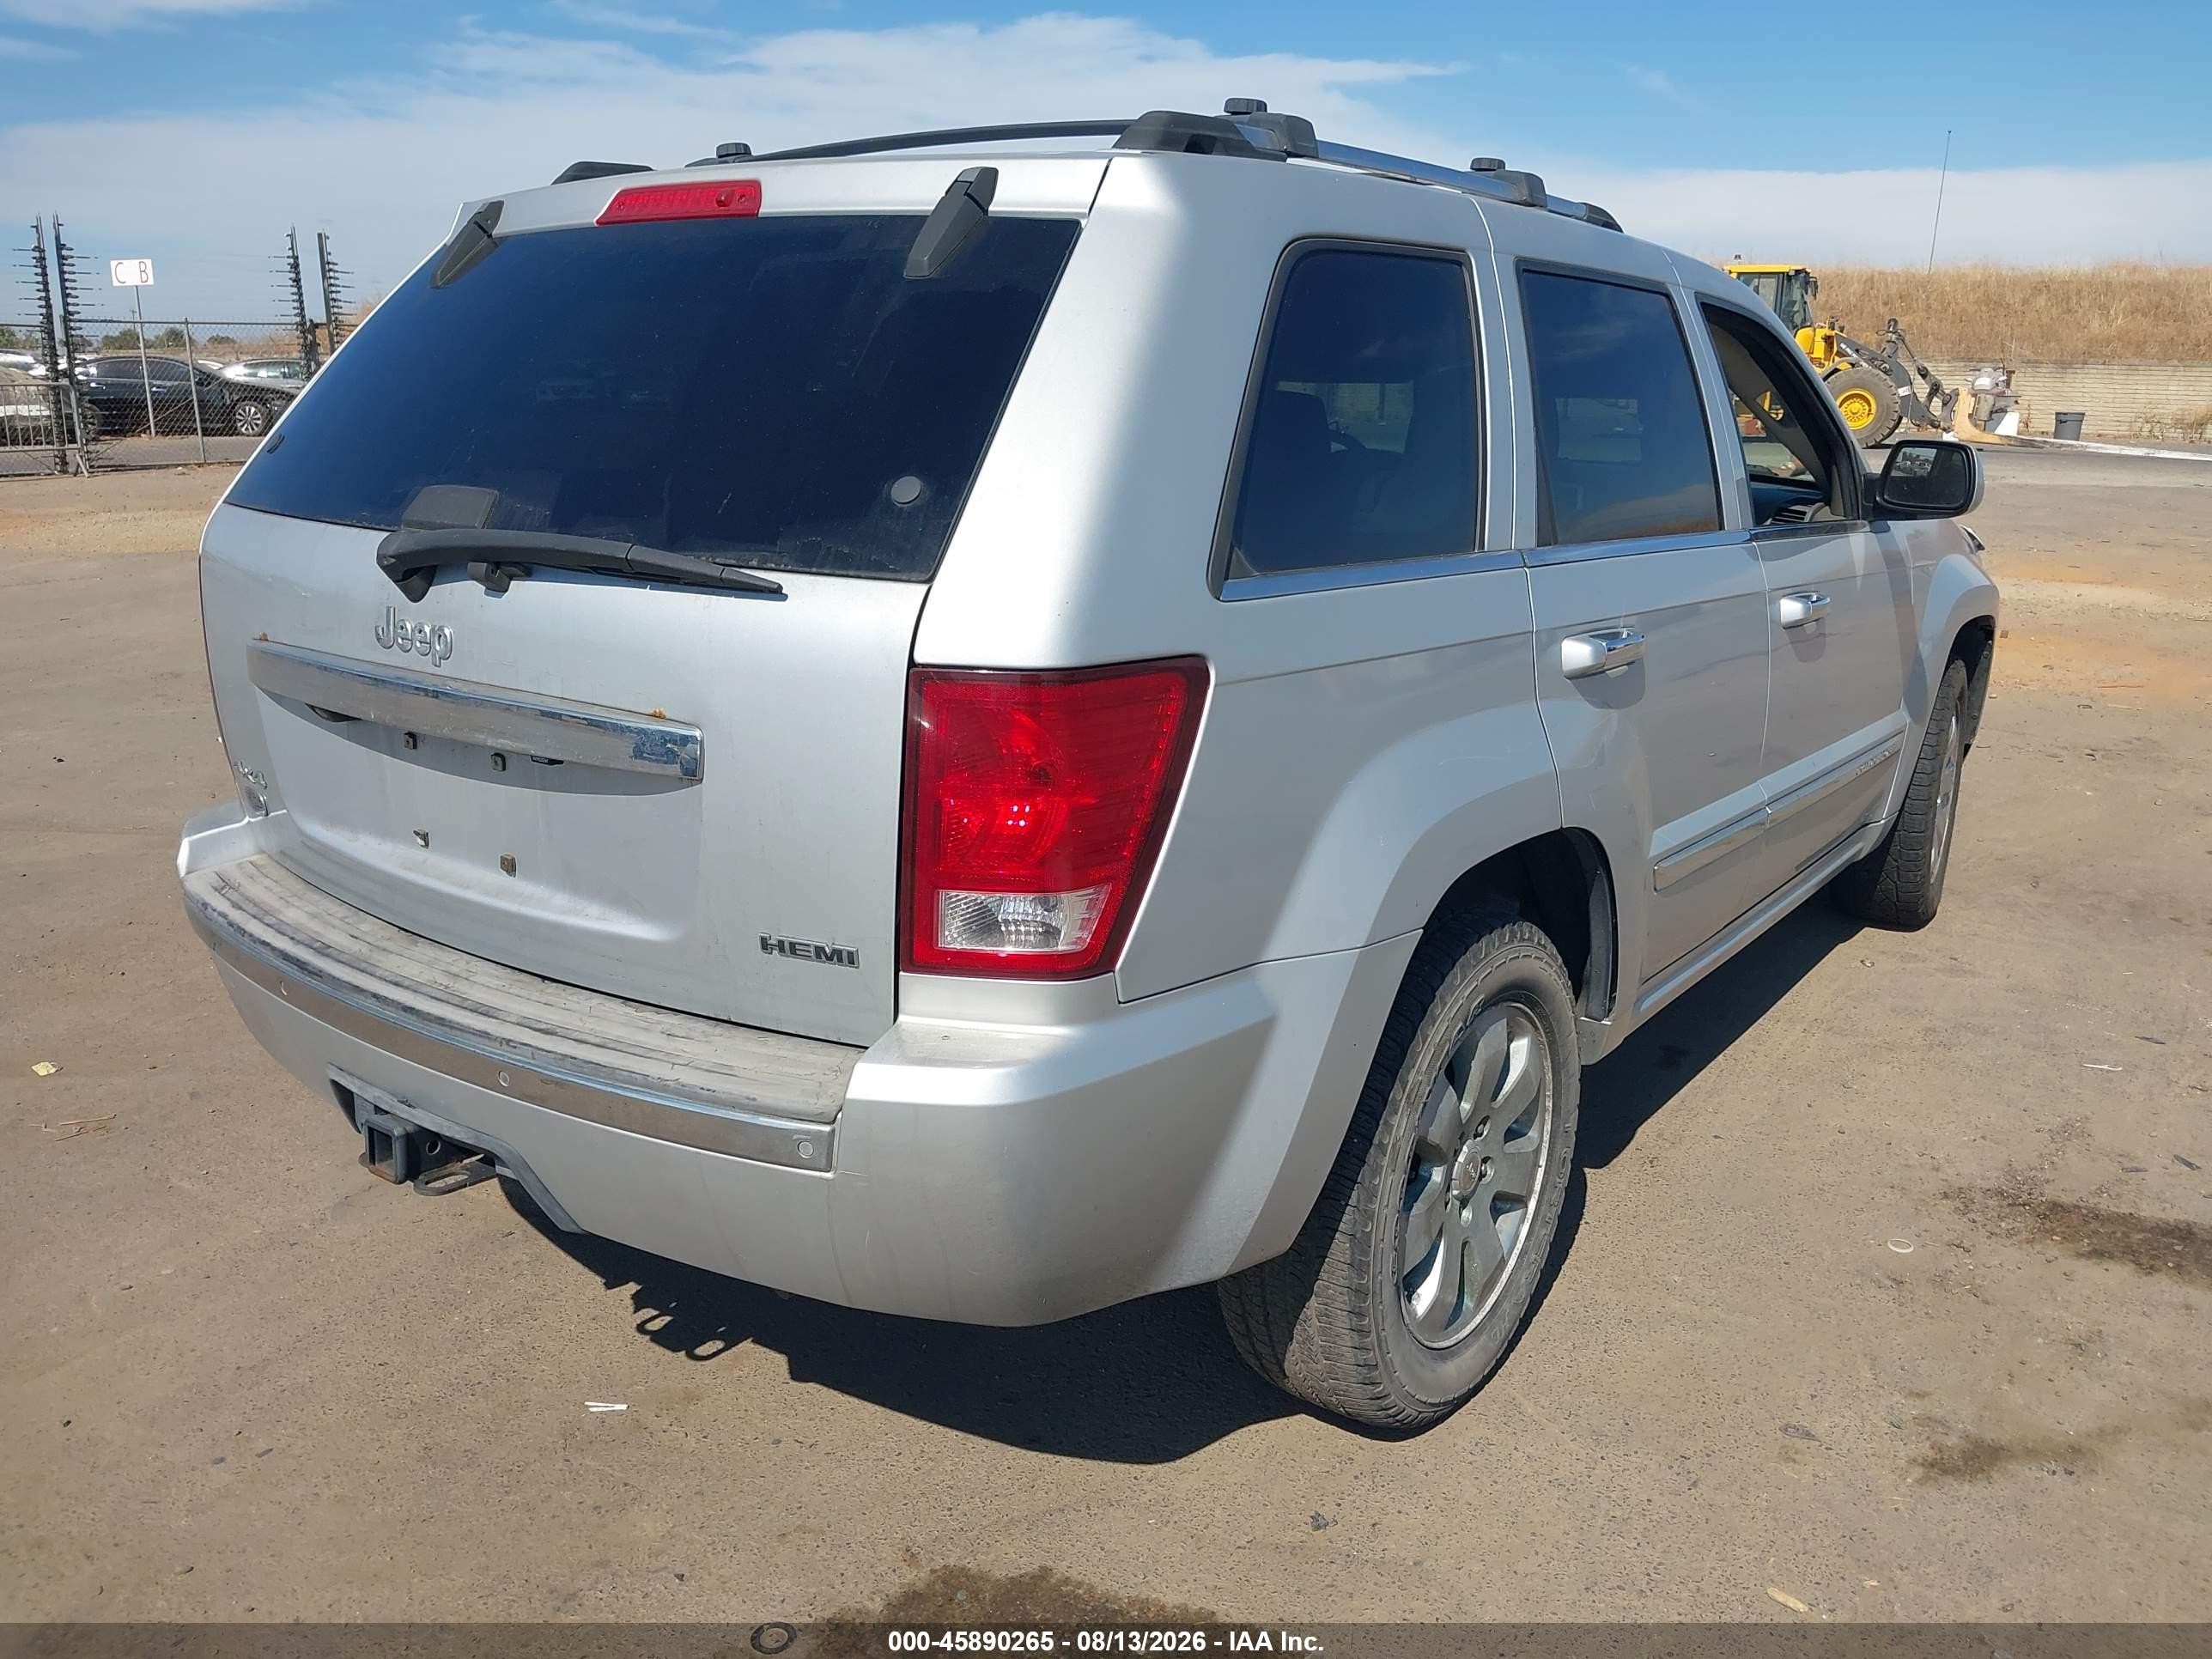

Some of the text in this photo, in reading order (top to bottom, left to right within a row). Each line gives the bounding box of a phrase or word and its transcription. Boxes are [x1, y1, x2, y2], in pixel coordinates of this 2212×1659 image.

[114, 260, 149, 284] C B
[374, 605, 453, 668] Jeep
[758, 933, 860, 969] HEMI
